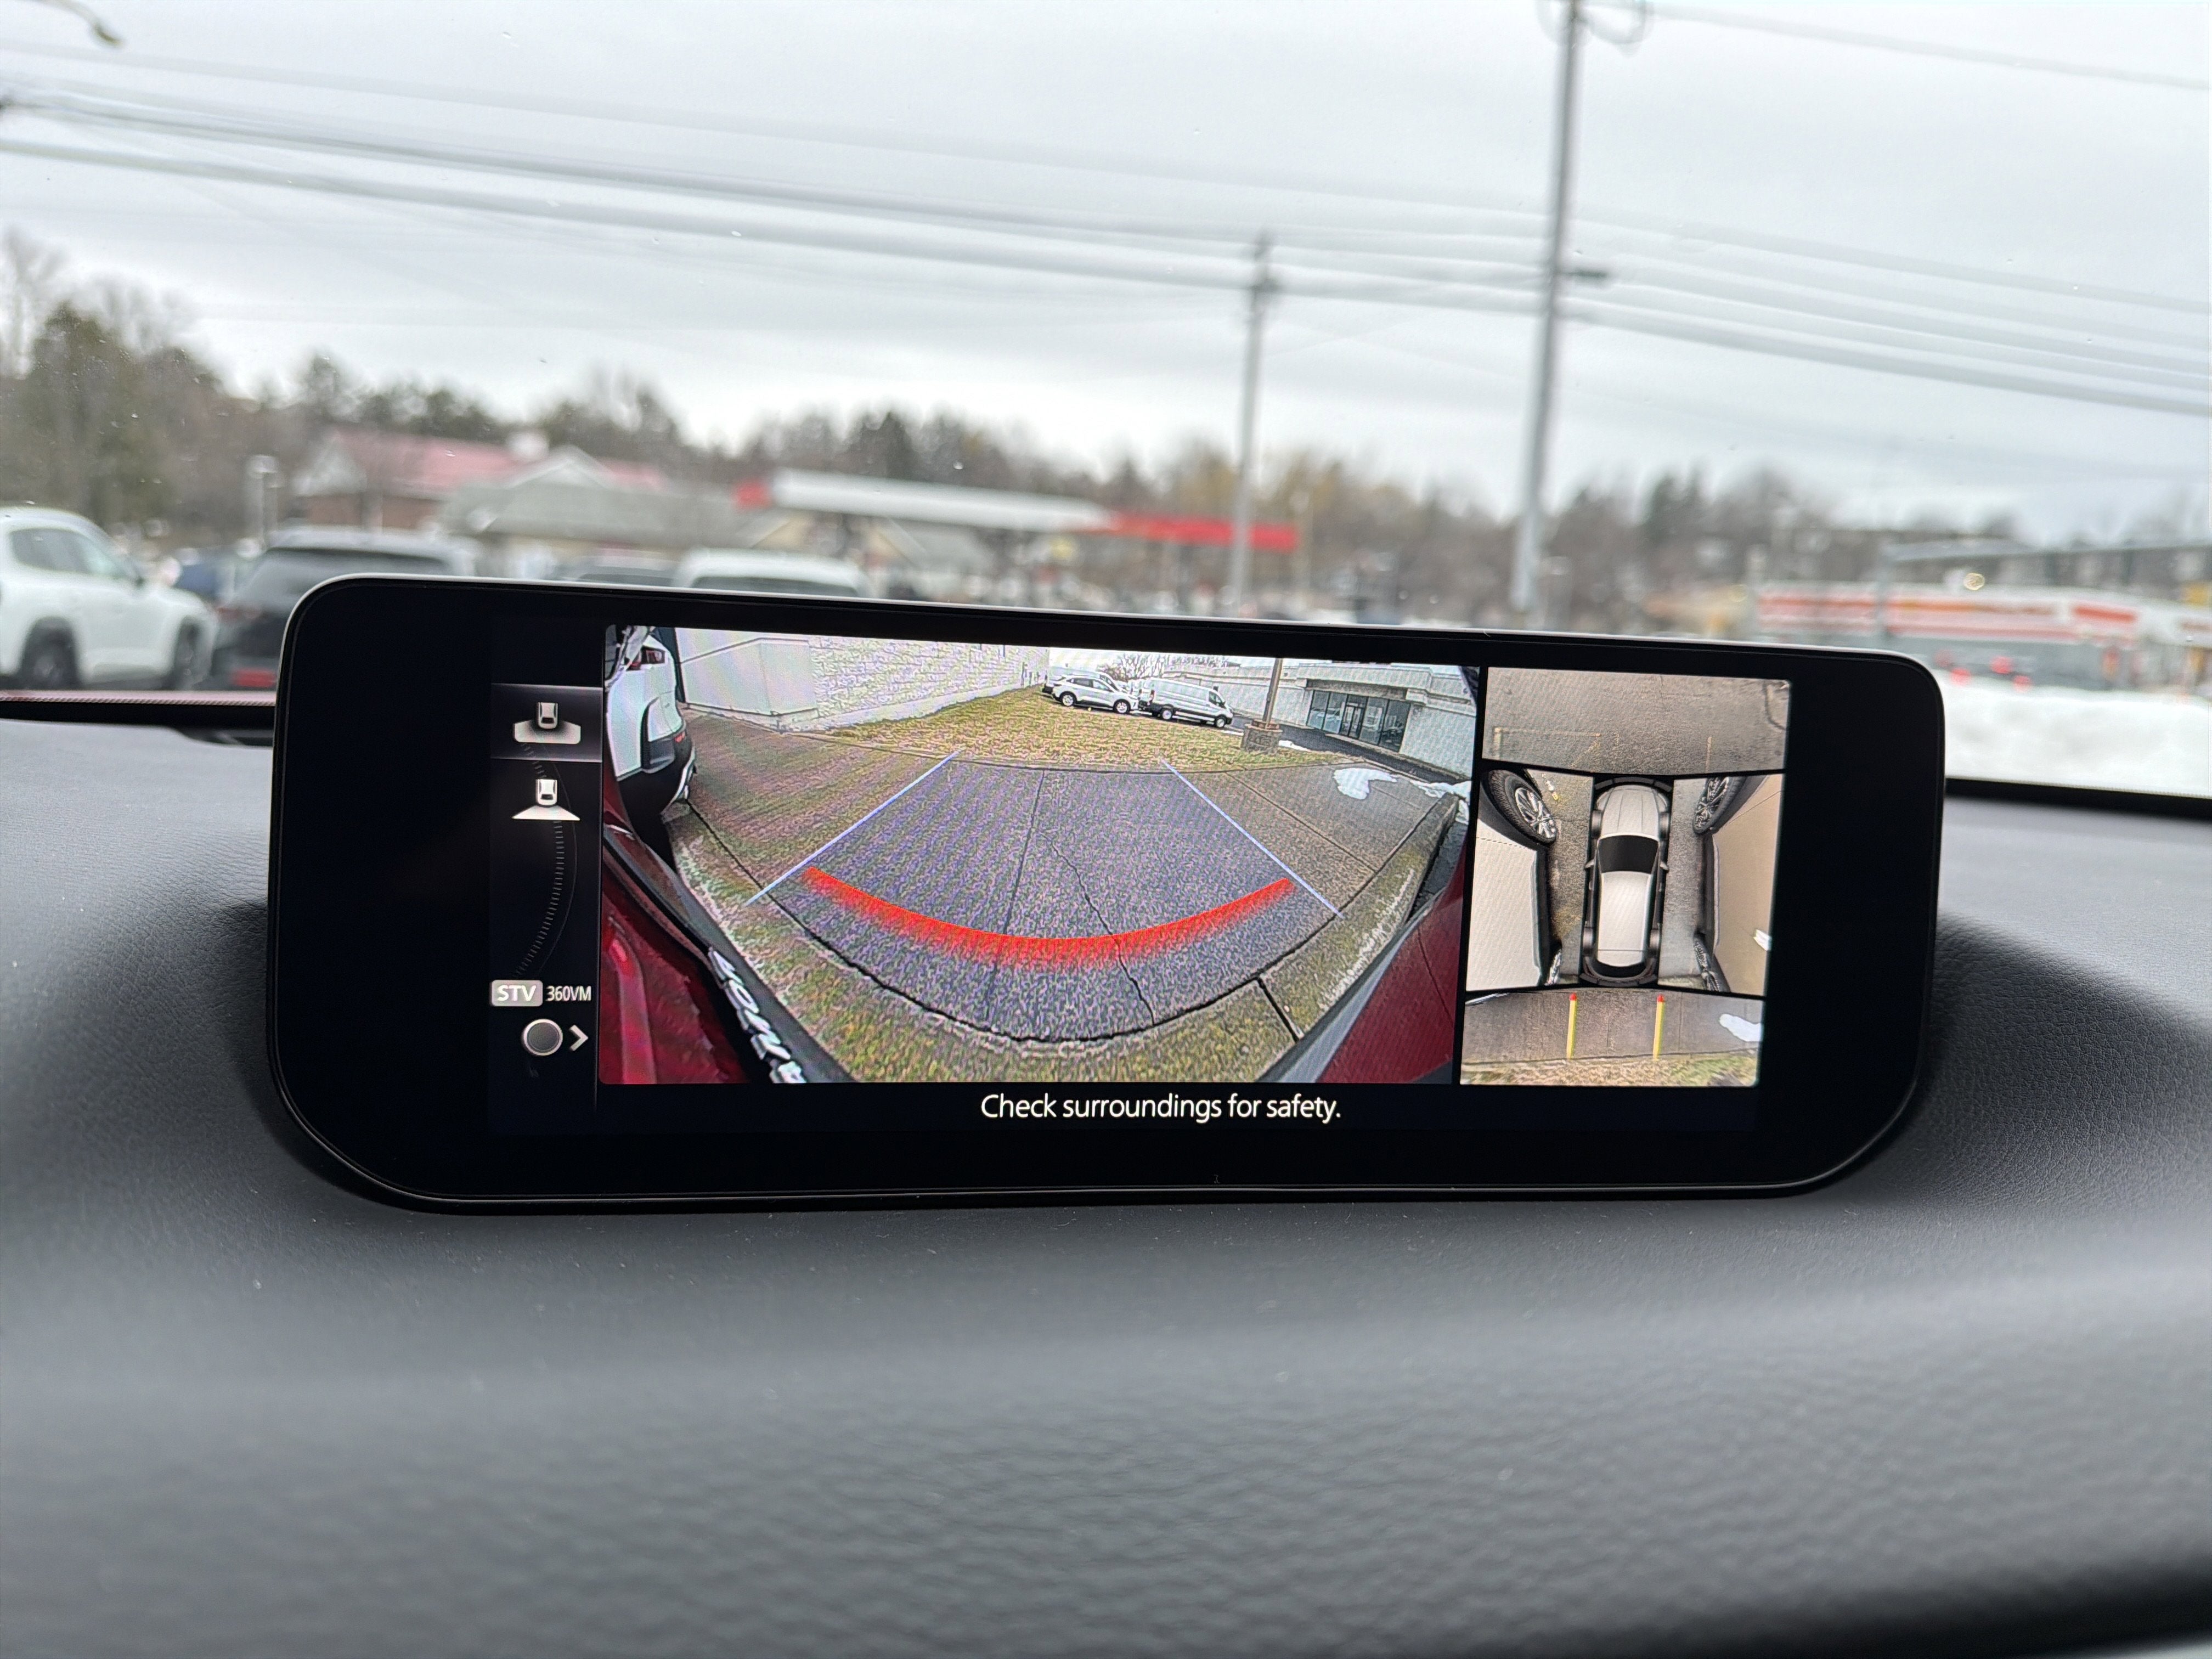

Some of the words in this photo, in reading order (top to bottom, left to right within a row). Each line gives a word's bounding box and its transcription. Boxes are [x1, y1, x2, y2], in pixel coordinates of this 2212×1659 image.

[496, 985, 537, 1001] STV
[546, 985, 591, 1002] 360VM
[981, 1092, 1057, 1118] Check
[1063, 1092, 1222, 1124] surroundings
[1227, 1093, 1262, 1118] for
[1266, 1093, 1341, 1124] safety.
